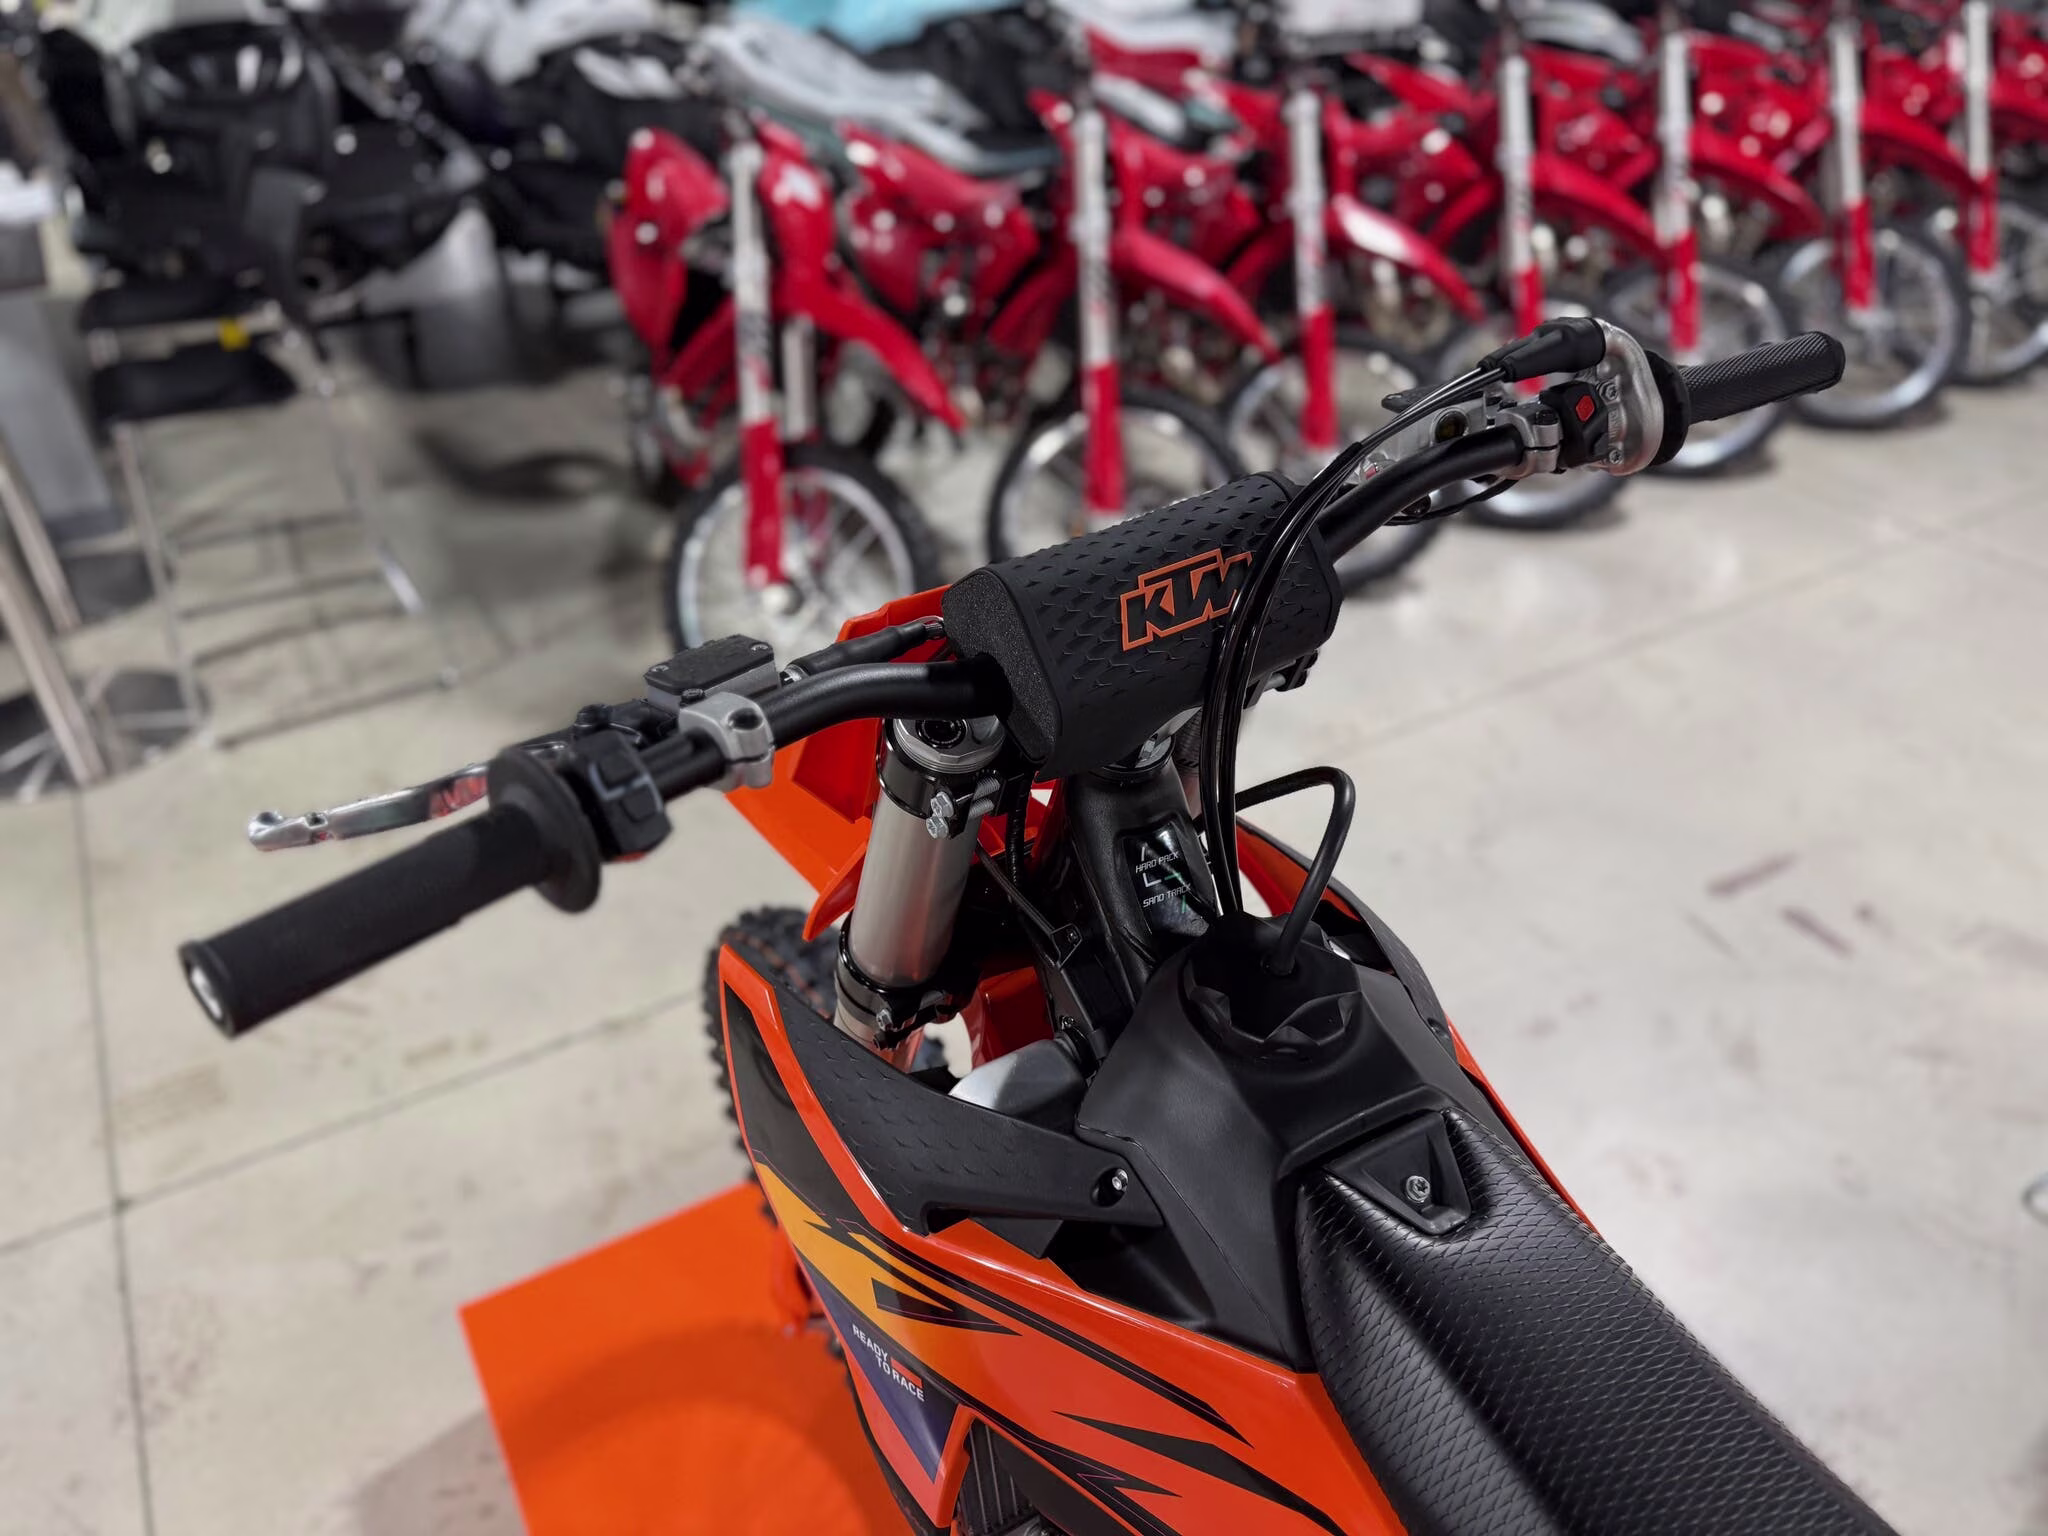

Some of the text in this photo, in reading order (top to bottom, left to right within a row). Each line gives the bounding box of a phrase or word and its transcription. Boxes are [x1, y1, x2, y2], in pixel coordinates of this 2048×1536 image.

[1135, 860, 1157, 874] HARD
[1143, 893, 1165, 908] SAND
[852, 1323, 888, 1362] READY
[875, 1354, 925, 1402] TO RACE
